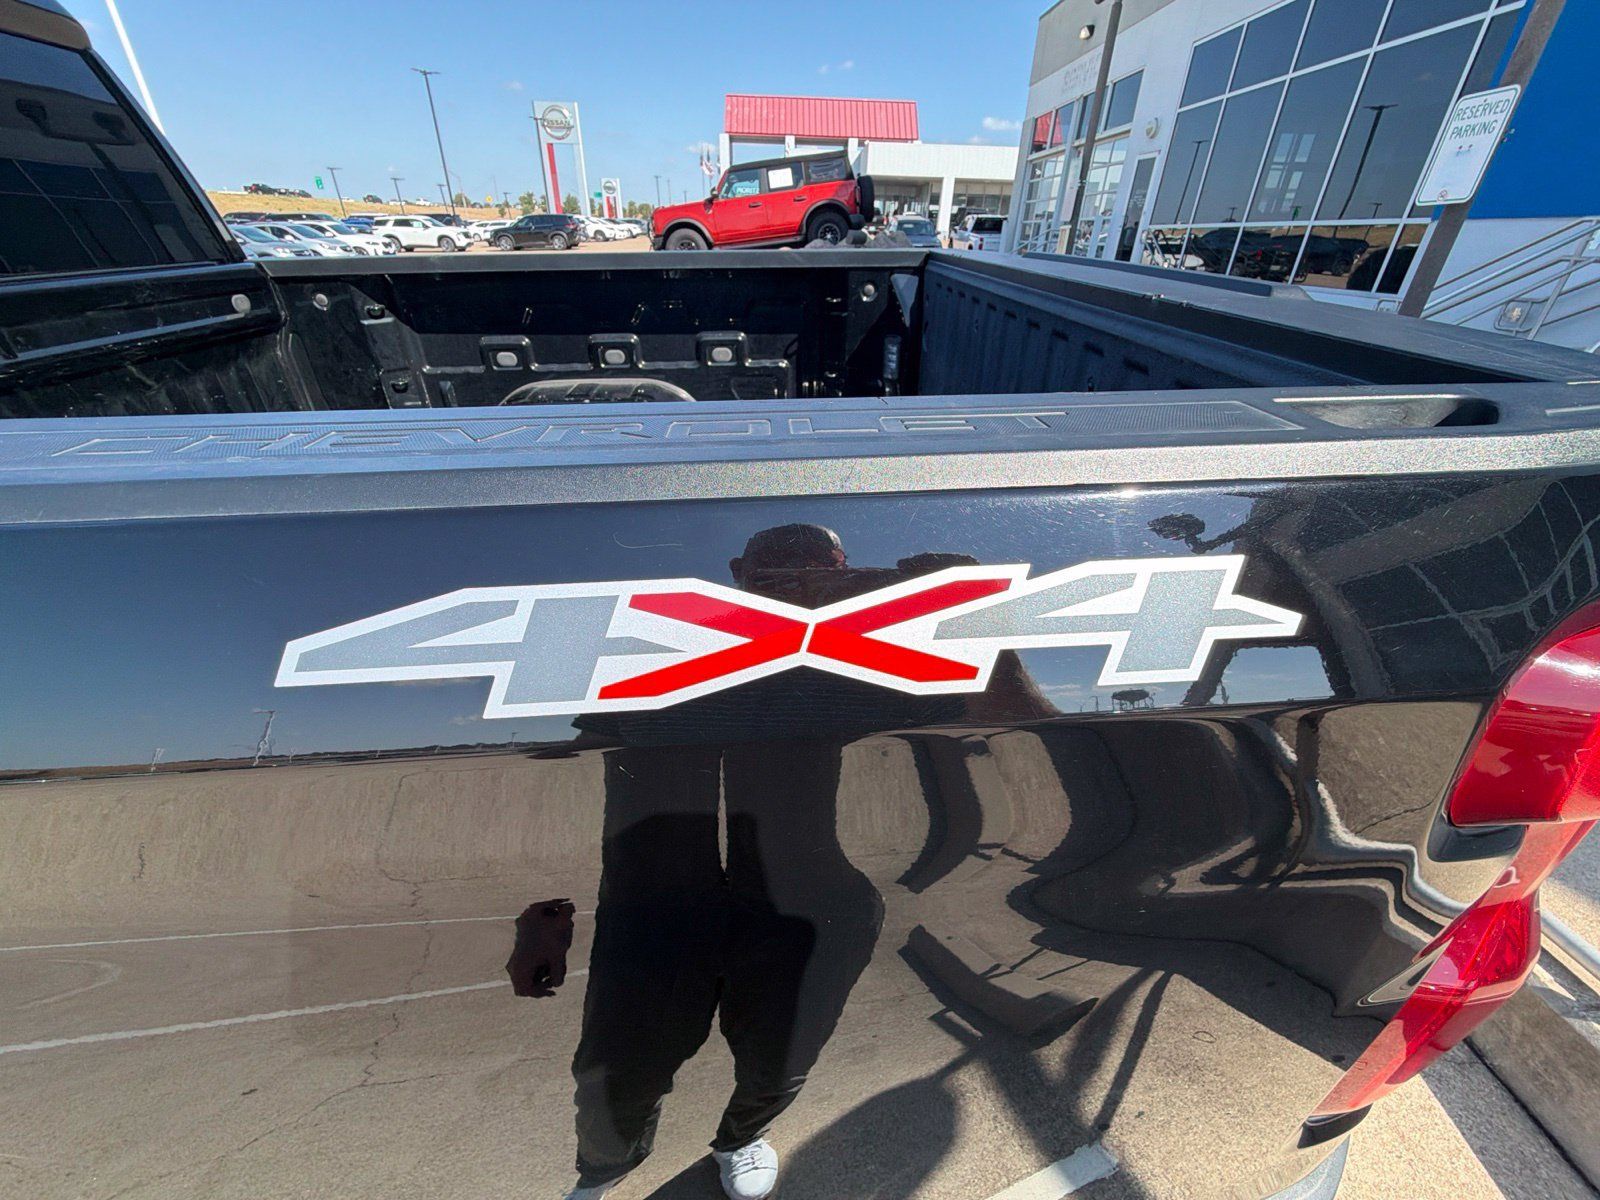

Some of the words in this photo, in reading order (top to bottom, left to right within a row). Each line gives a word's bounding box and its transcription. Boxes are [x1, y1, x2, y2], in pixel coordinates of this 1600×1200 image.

[1454, 98, 1511, 121] RESERVED
[1449, 120, 1498, 139] PARKING
[51, 410, 1068, 457] CHEVROLET
